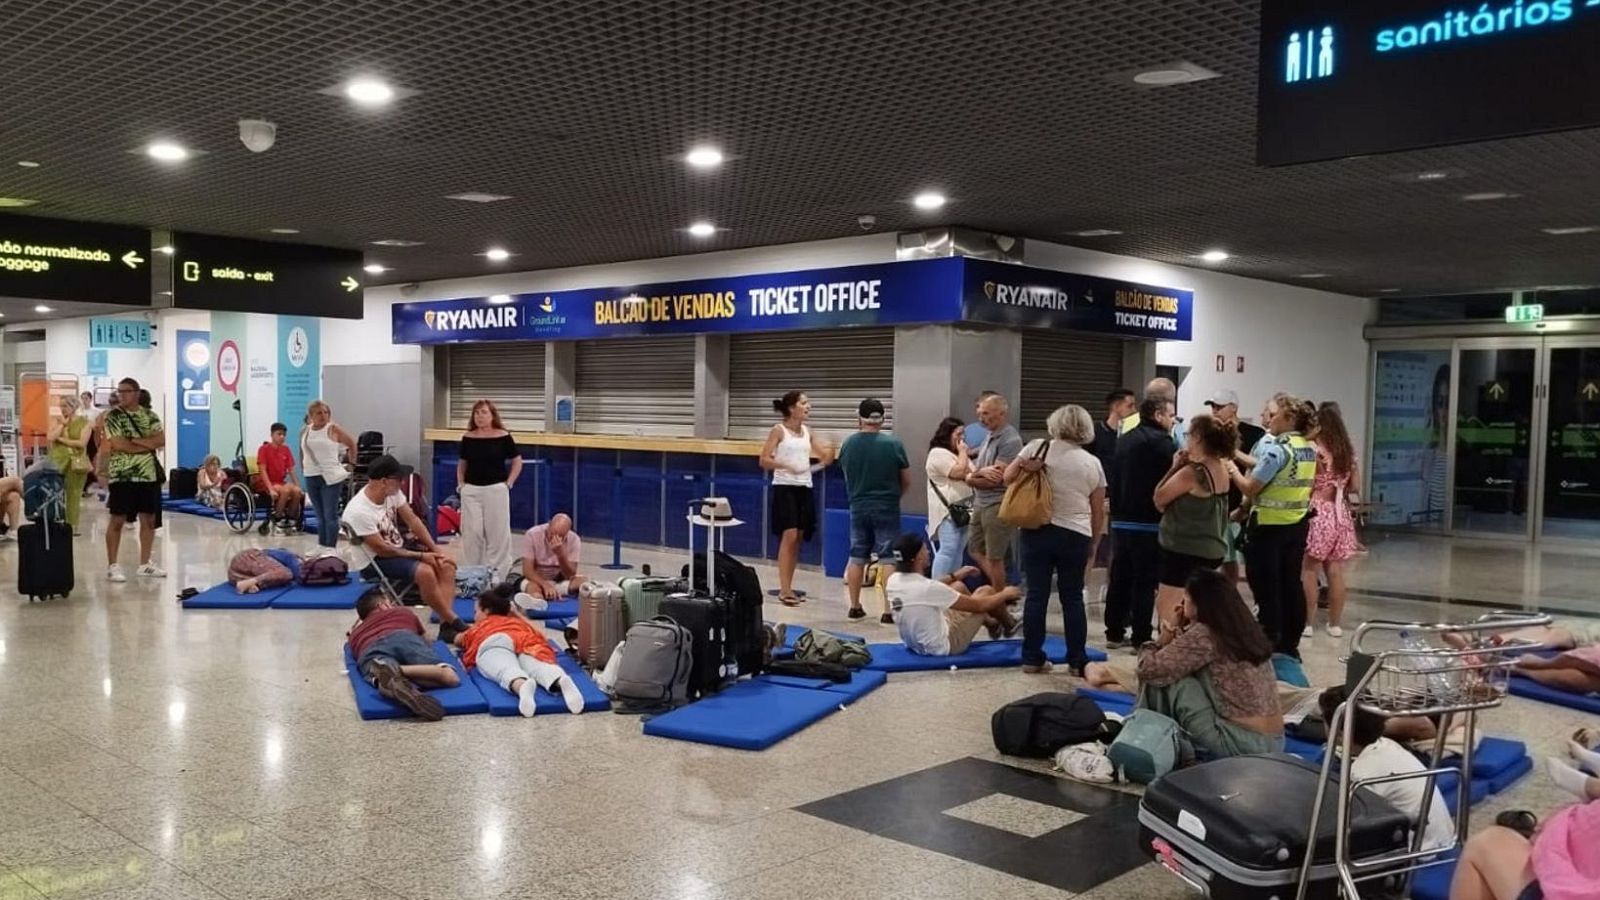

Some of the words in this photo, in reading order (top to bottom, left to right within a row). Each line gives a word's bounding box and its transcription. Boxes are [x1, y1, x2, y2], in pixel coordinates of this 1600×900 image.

[1376, 0, 1572, 51] sanitários
[24, 245, 111, 261] normalizada
[253, 271, 274, 282] exit
[595, 293, 648, 325] BALCÃO
[651, 296, 671, 322] DE
[673, 291, 736, 320] VENDAS
[748, 285, 812, 316] TICKET
[814, 280, 881, 312] OFFICE
[996, 284, 1068, 311] RYANAIR
[1143, 294, 1153, 310] DE
[1153, 295, 1178, 314] VENDAS
[436, 307, 517, 331] RYANAIR
[1115, 311, 1147, 327] TICKET
[1148, 315, 1177, 331] OFFICE
